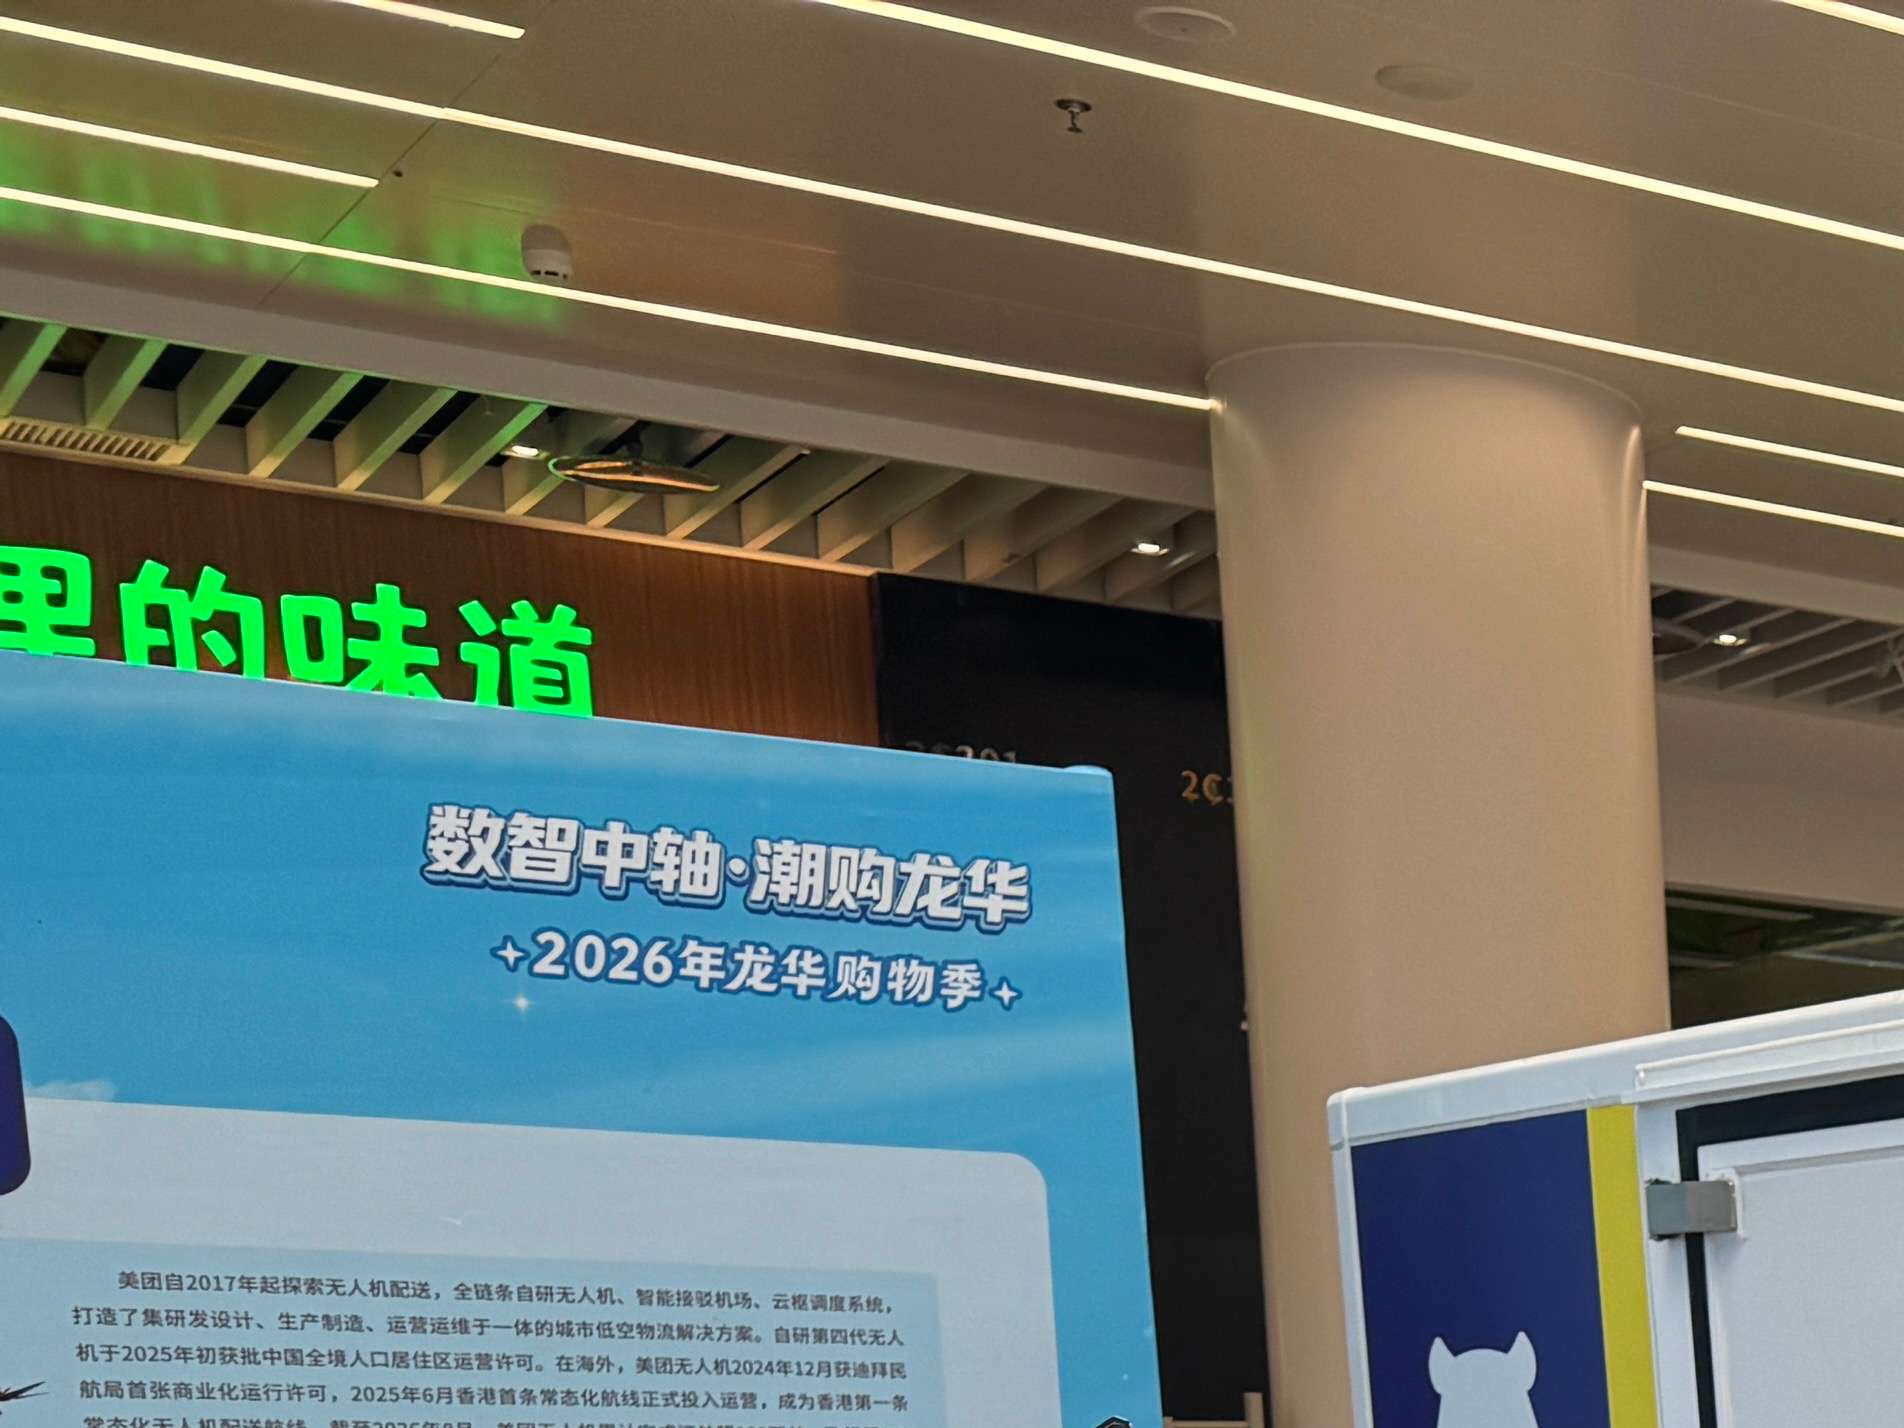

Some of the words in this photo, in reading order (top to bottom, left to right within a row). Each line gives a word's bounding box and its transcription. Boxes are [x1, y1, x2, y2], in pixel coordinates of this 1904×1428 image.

[424, 804, 1031, 930] 数智中轴·潮购龙华
[532, 930, 989, 1010] 2026年龙华购物季
